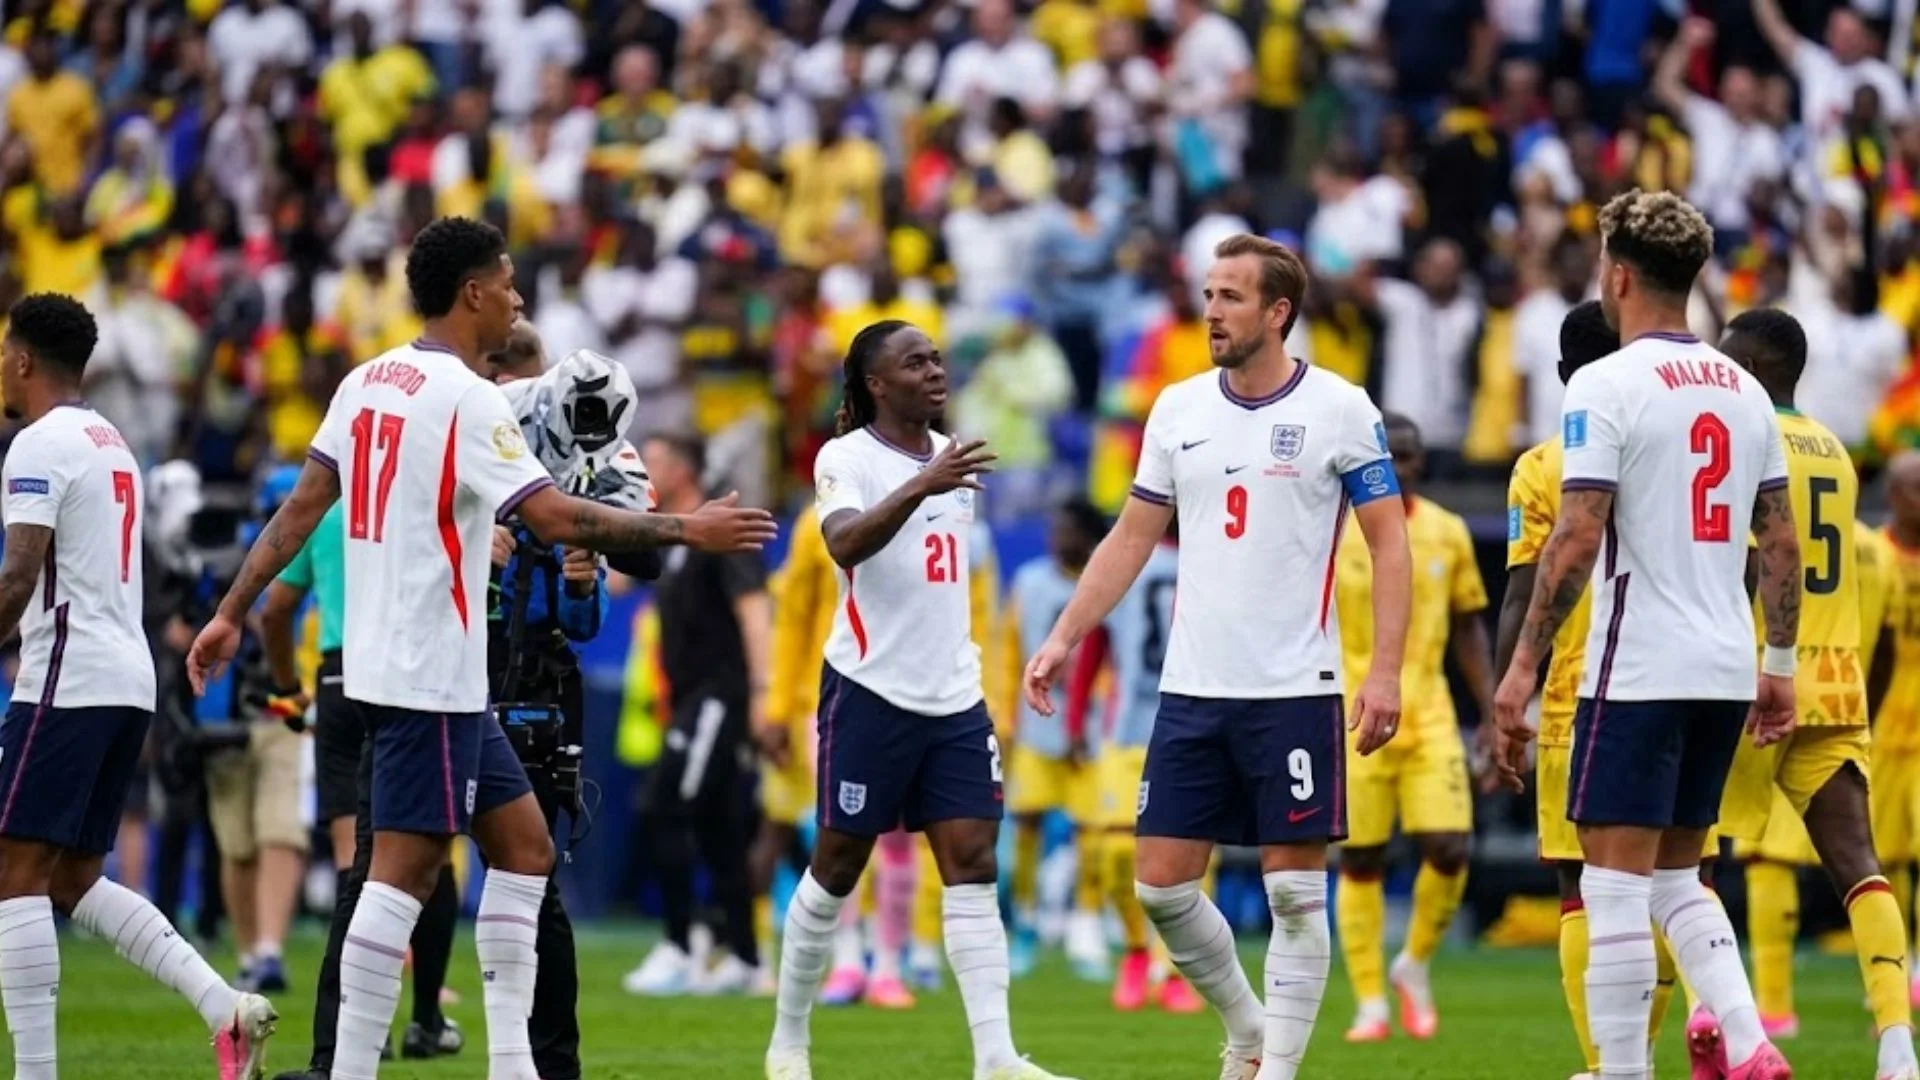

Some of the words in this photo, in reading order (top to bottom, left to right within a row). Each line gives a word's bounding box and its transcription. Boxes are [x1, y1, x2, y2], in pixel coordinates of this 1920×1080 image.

[1654, 359, 1741, 394] WALKER
[350, 407, 405, 543] 17
[1224, 485, 1248, 539] 9
[1690, 411, 1731, 542] 2
[112, 470, 135, 584] 7
[925, 533, 958, 583] 21
[1804, 476, 1841, 594] 5
[1287, 748, 1314, 800] 9
